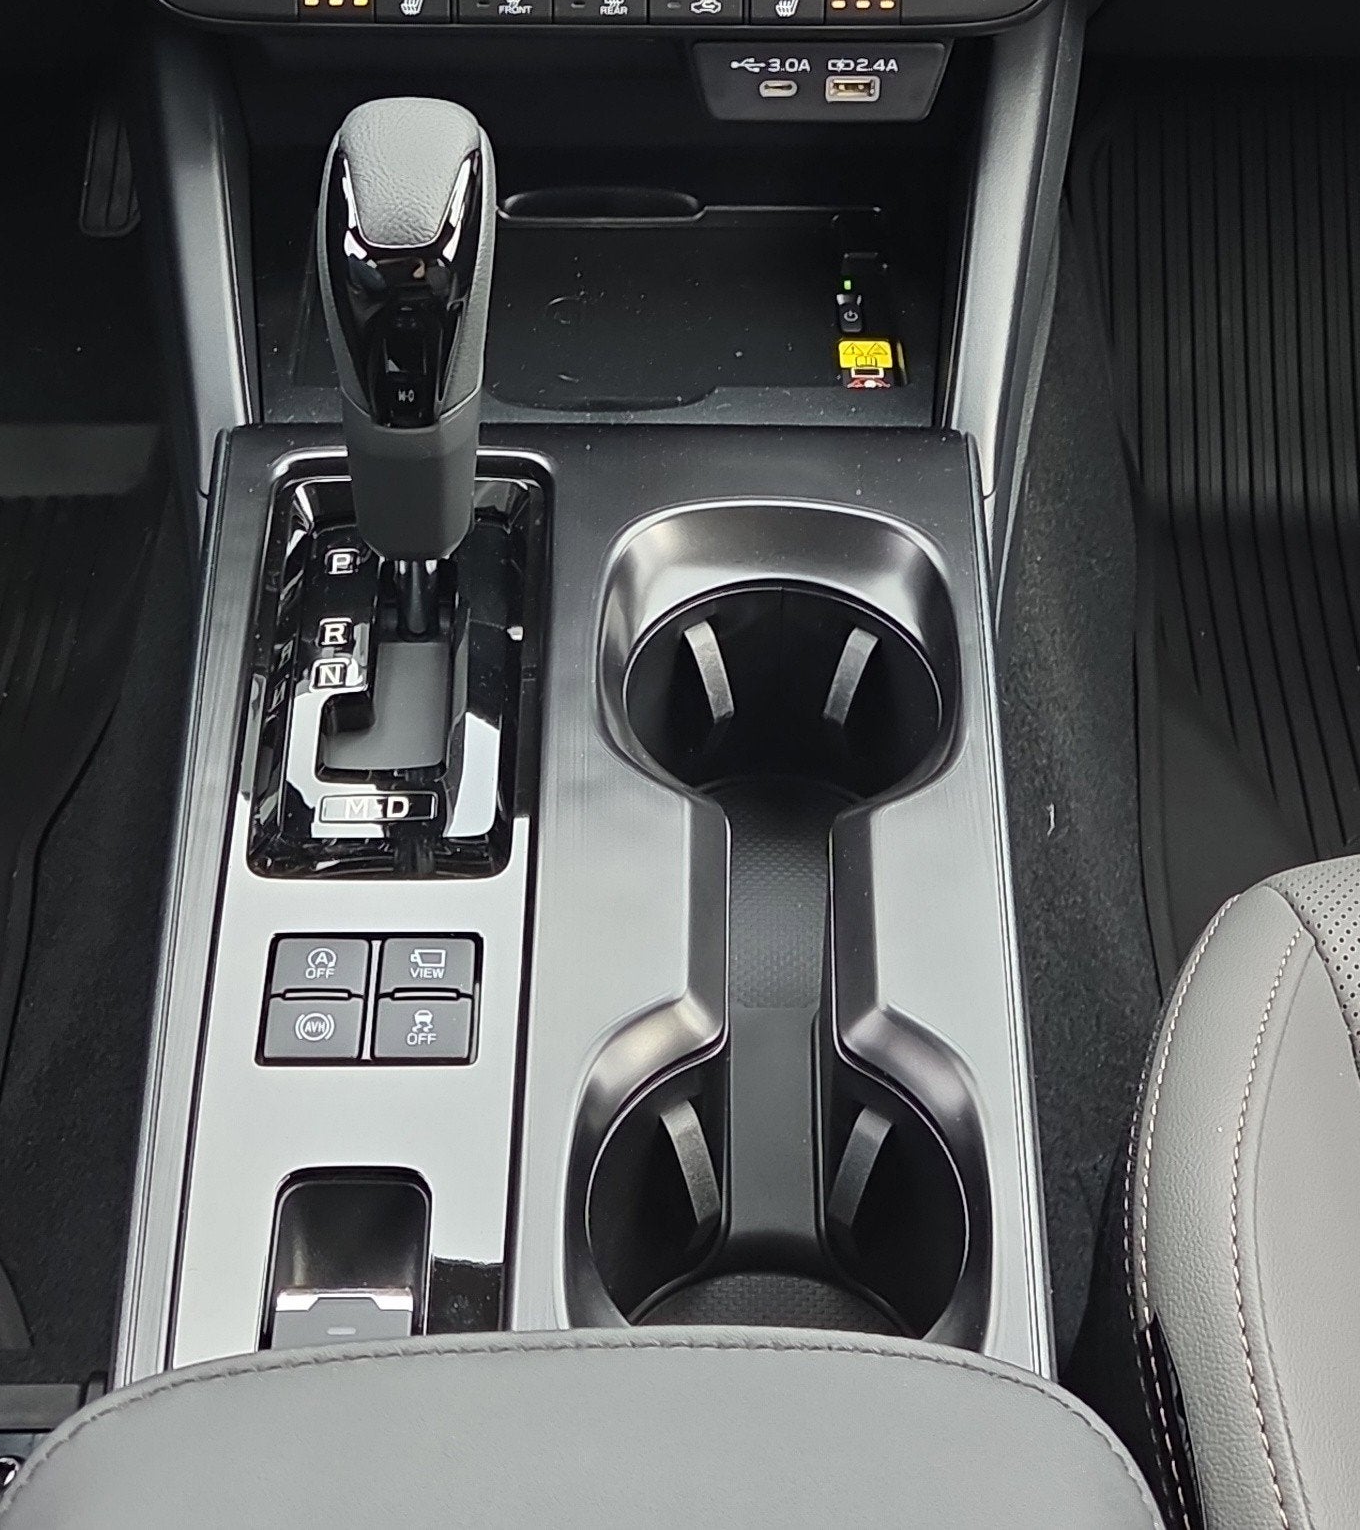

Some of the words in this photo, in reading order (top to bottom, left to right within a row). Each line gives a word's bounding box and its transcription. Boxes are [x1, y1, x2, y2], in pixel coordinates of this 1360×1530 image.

[498, 5, 532, 15] FRONT
[600, 5, 628, 15] REAR
[768, 58, 811, 73] 3.0A
[856, 58, 899, 73] 2.4A
[330, 553, 353, 574] P
[321, 622, 348, 646] R
[318, 663, 345, 687] N
[386, 796, 409, 818] D
[305, 968, 335, 979] OFF
[410, 968, 445, 979] VIEW
[304, 1021, 325, 1033] AVH
[406, 1033, 437, 1045] OFF
